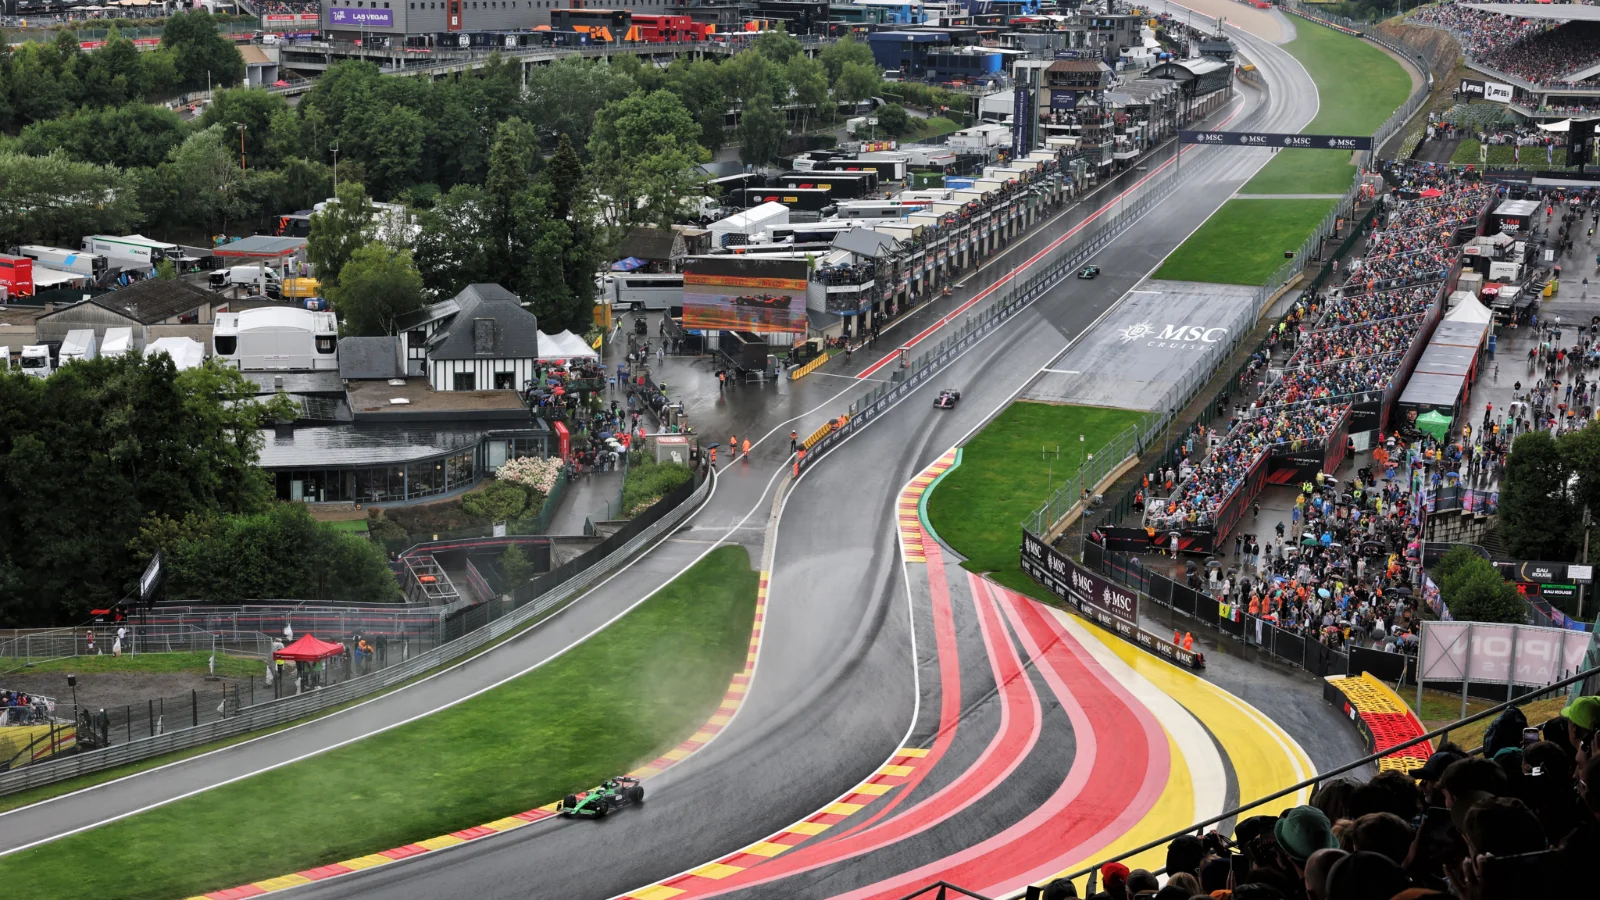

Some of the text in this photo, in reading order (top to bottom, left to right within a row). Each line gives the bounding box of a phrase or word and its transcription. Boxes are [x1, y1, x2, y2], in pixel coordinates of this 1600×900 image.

[1154, 324, 1227, 342] MSC
[1148, 341, 1214, 351] CRUISES
[1053, 556, 1065, 575] MSC
[1078, 573, 1093, 593] MSC
[1112, 591, 1132, 612] MSC
[1102, 614, 1111, 624] MSC
[1121, 623, 1130, 634] MSC
[1141, 634, 1151, 644] MSC
[1161, 643, 1172, 654] MSC
[1181, 652, 1192, 663] MSC
